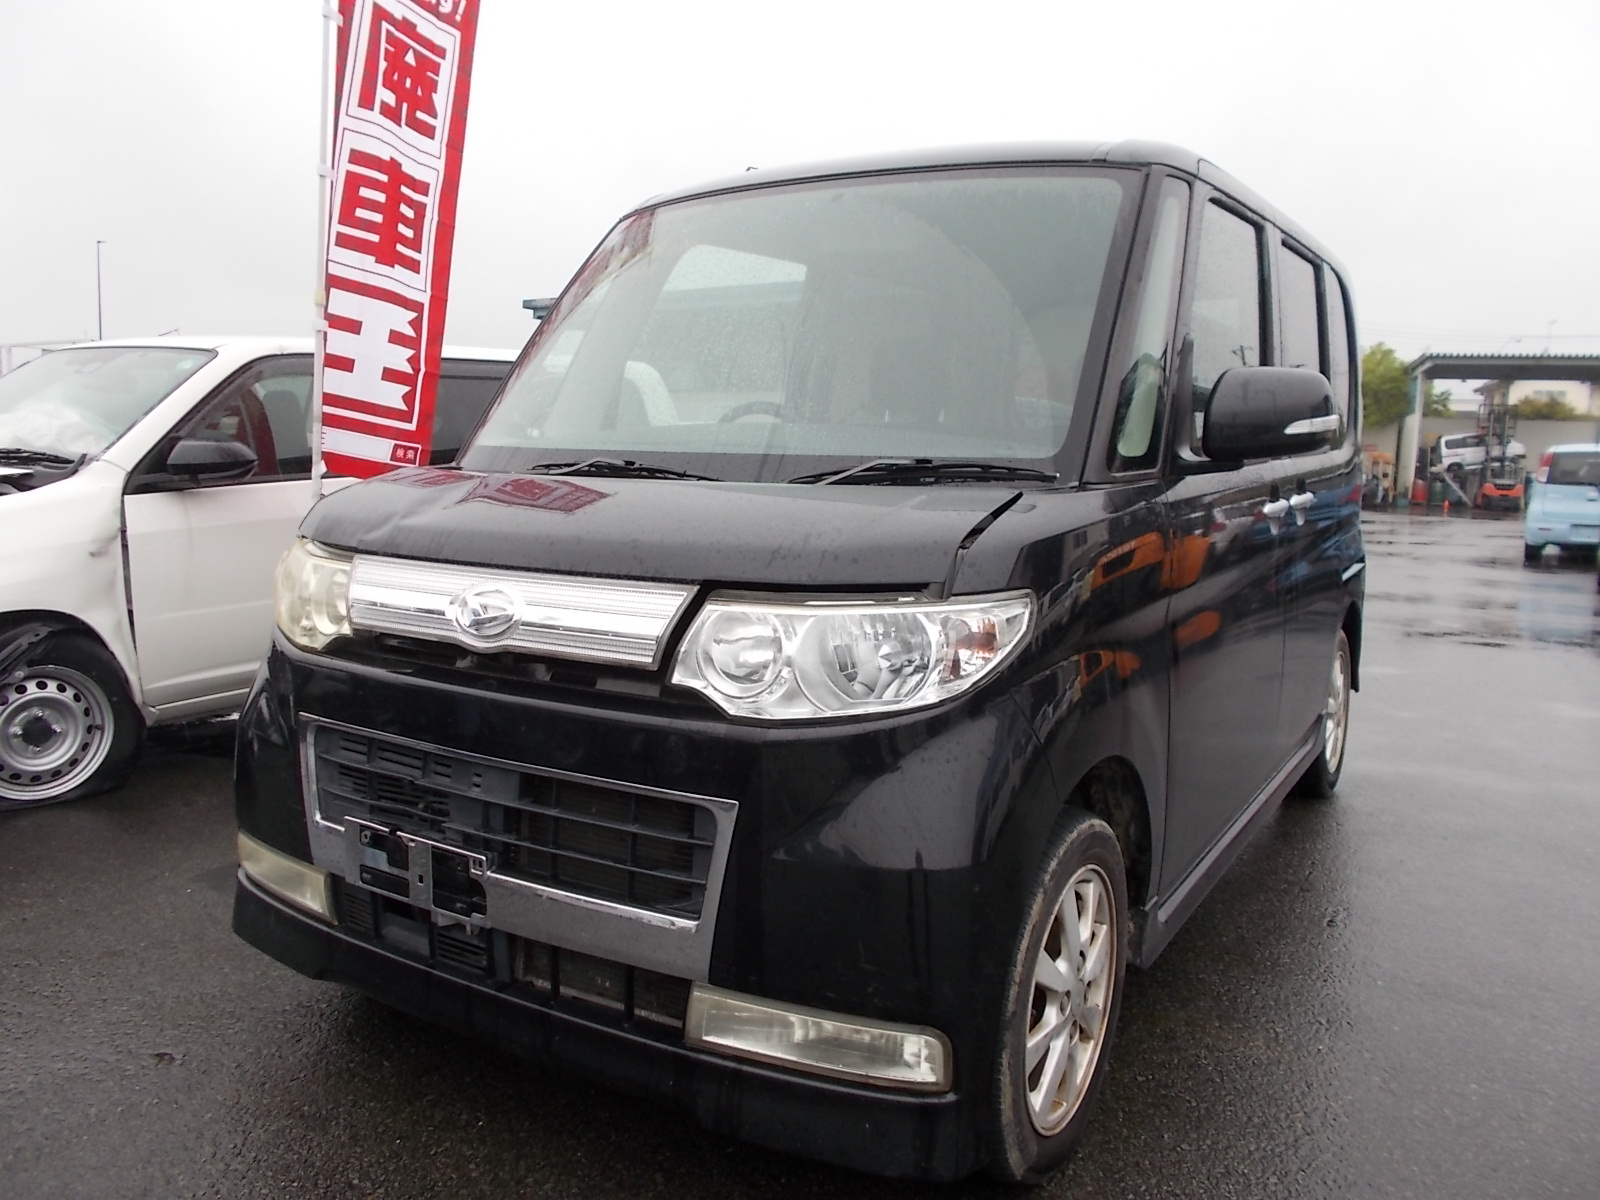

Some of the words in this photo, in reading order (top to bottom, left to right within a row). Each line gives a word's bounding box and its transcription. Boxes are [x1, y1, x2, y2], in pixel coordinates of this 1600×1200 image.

[322, 0, 448, 411] 廃車王
[395, 446, 415, 460] 検索
